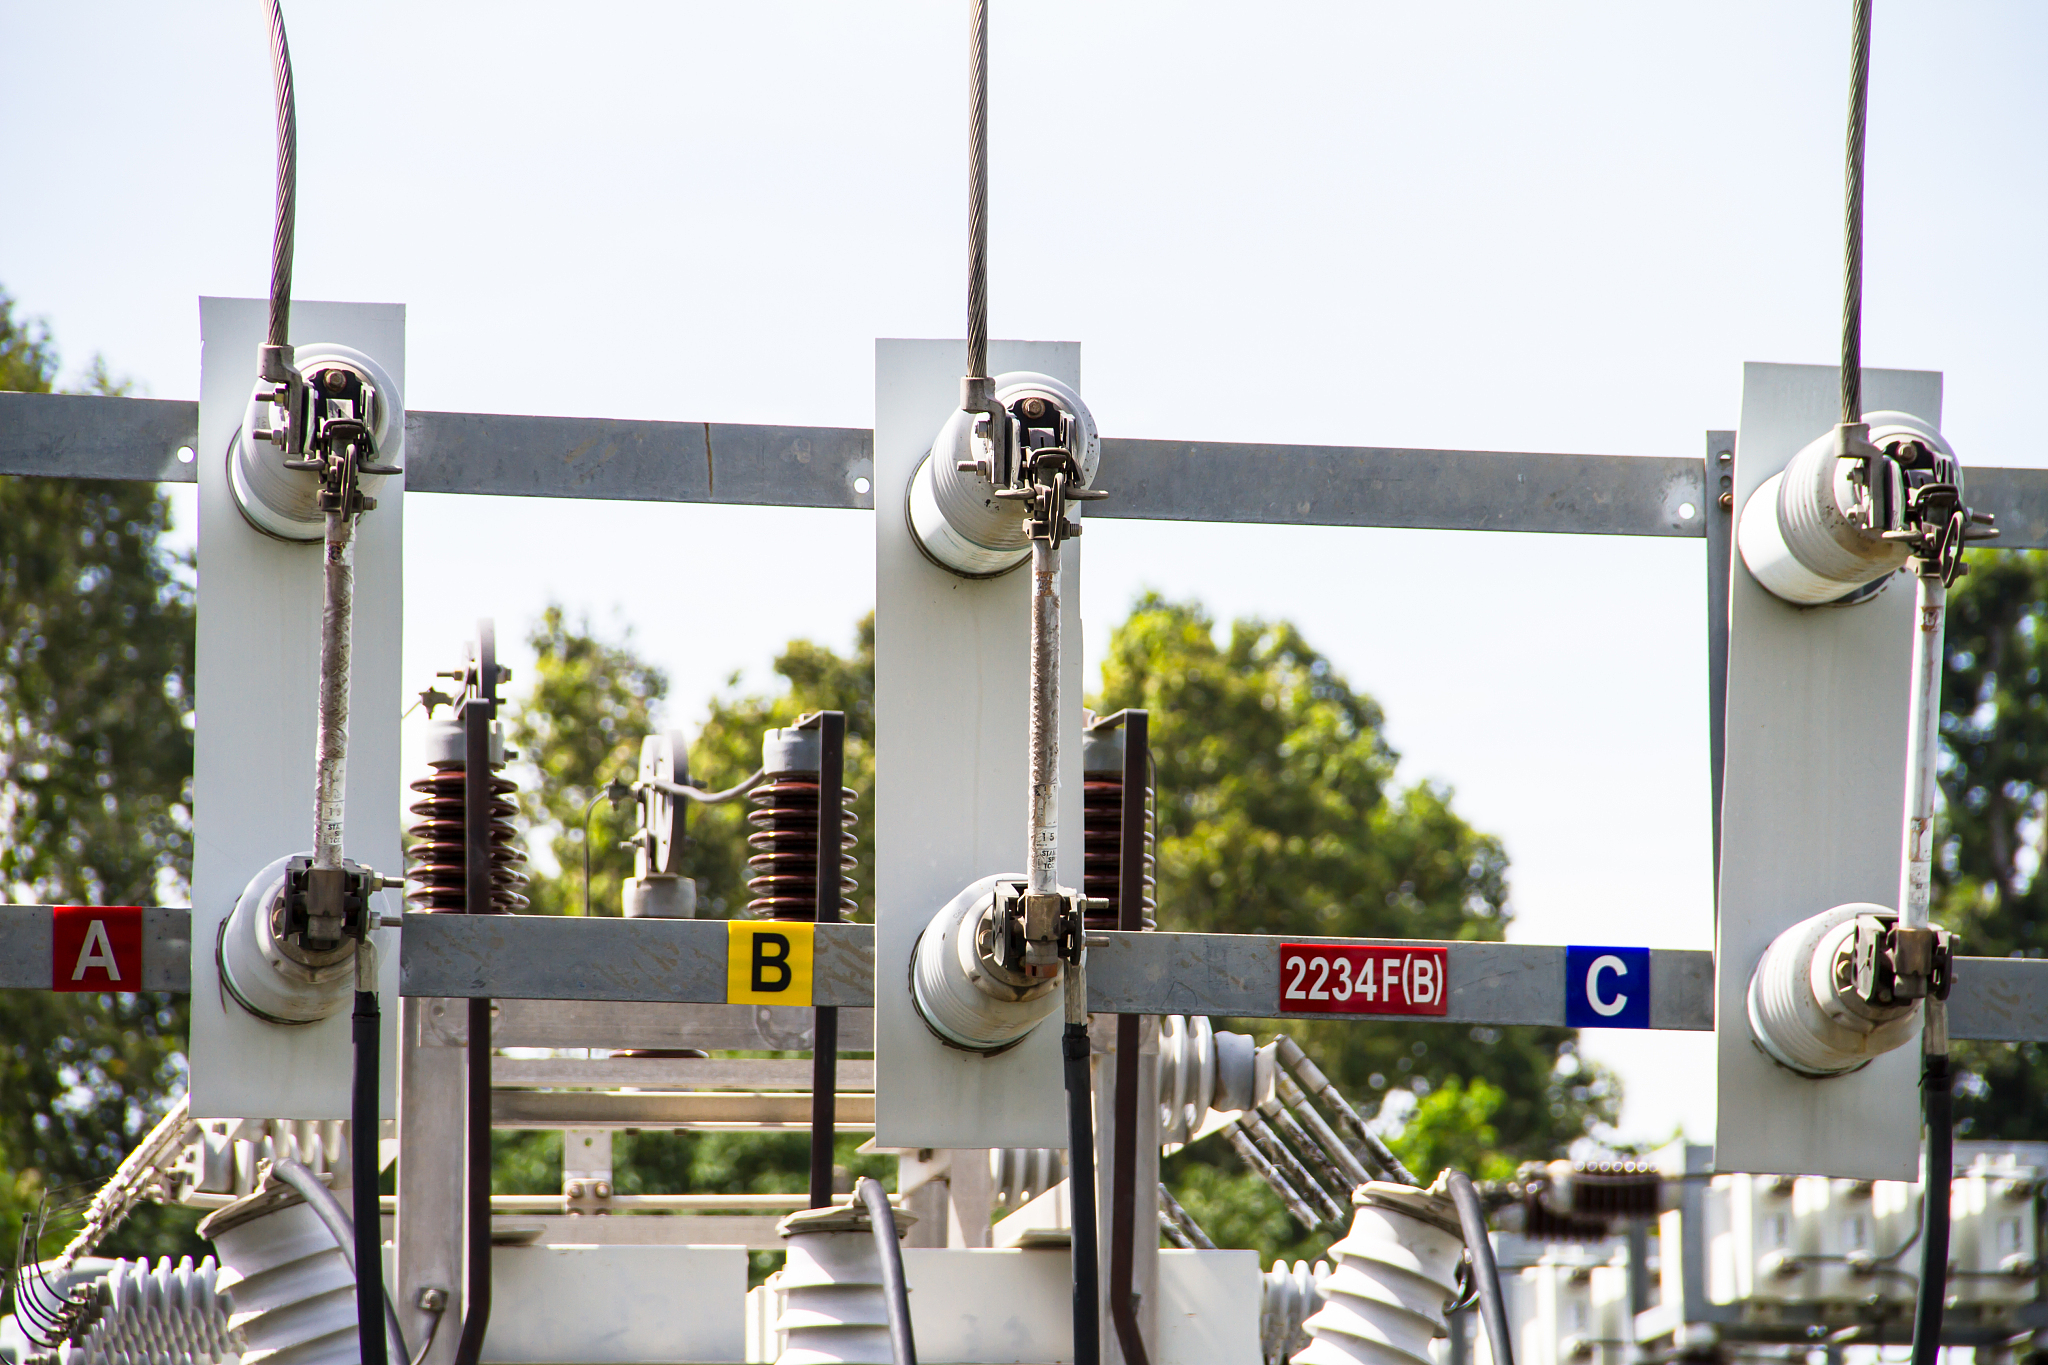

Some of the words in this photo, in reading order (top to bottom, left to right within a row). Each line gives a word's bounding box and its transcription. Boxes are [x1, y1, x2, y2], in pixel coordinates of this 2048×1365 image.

[71, 920, 121, 981] A
[751, 932, 792, 993] B
[1285, 953, 1444, 1006] 2234F(B)
[1585, 954, 1628, 1016] C
